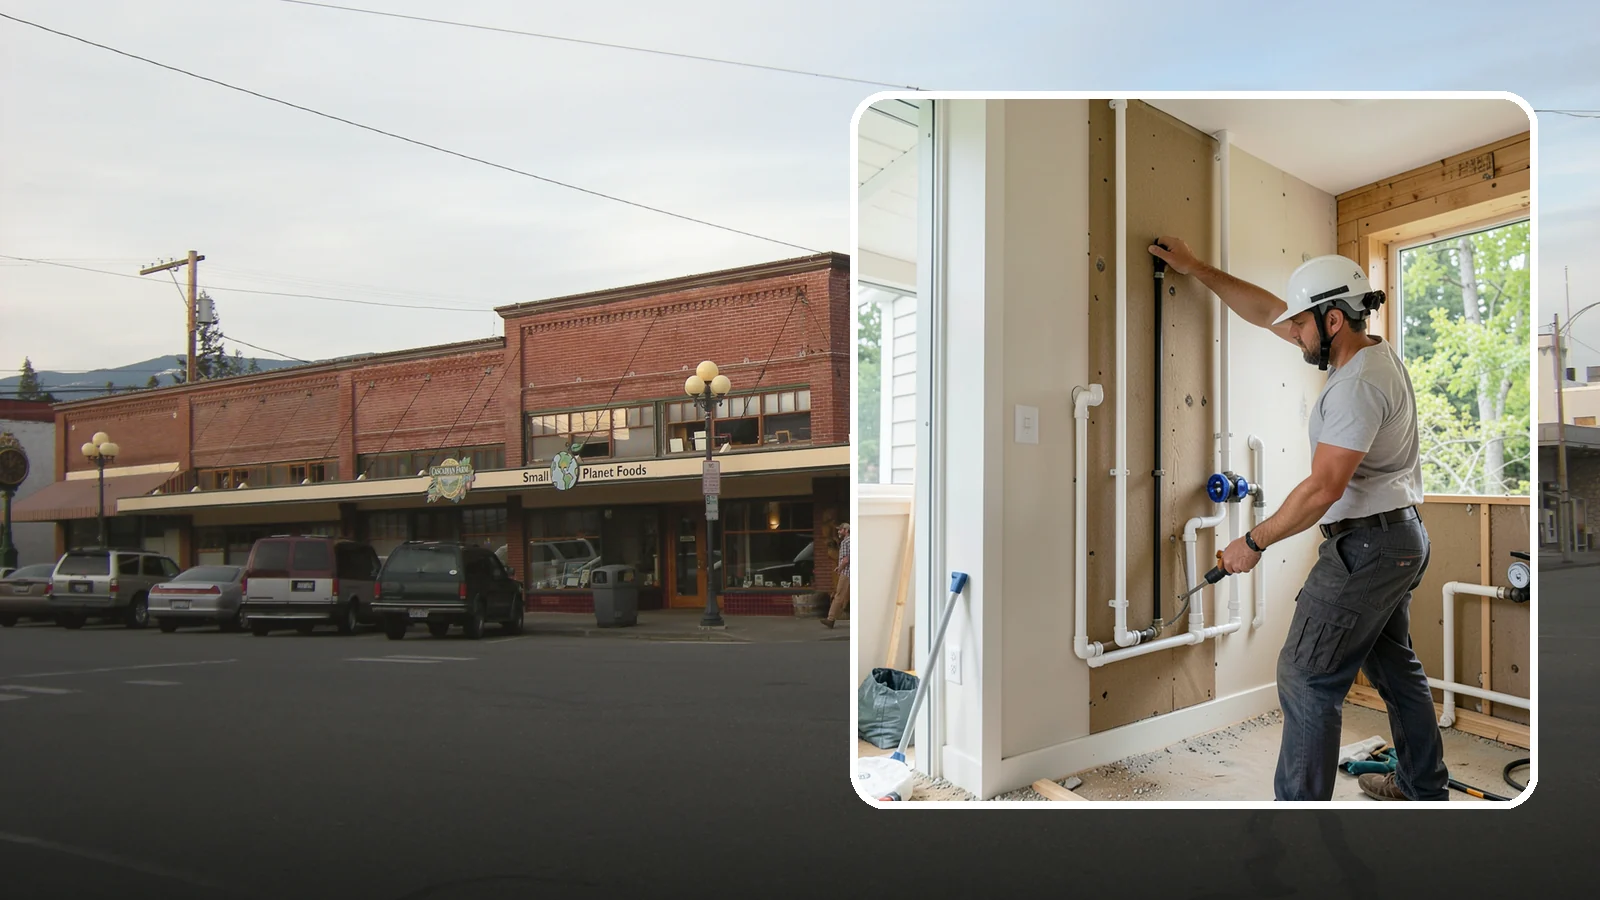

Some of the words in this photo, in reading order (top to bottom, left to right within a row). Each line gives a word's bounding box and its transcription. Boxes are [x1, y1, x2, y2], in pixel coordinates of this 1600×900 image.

[523, 471, 549, 482] Small
[583, 468, 614, 479] Planet
[617, 464, 647, 477] Foods
